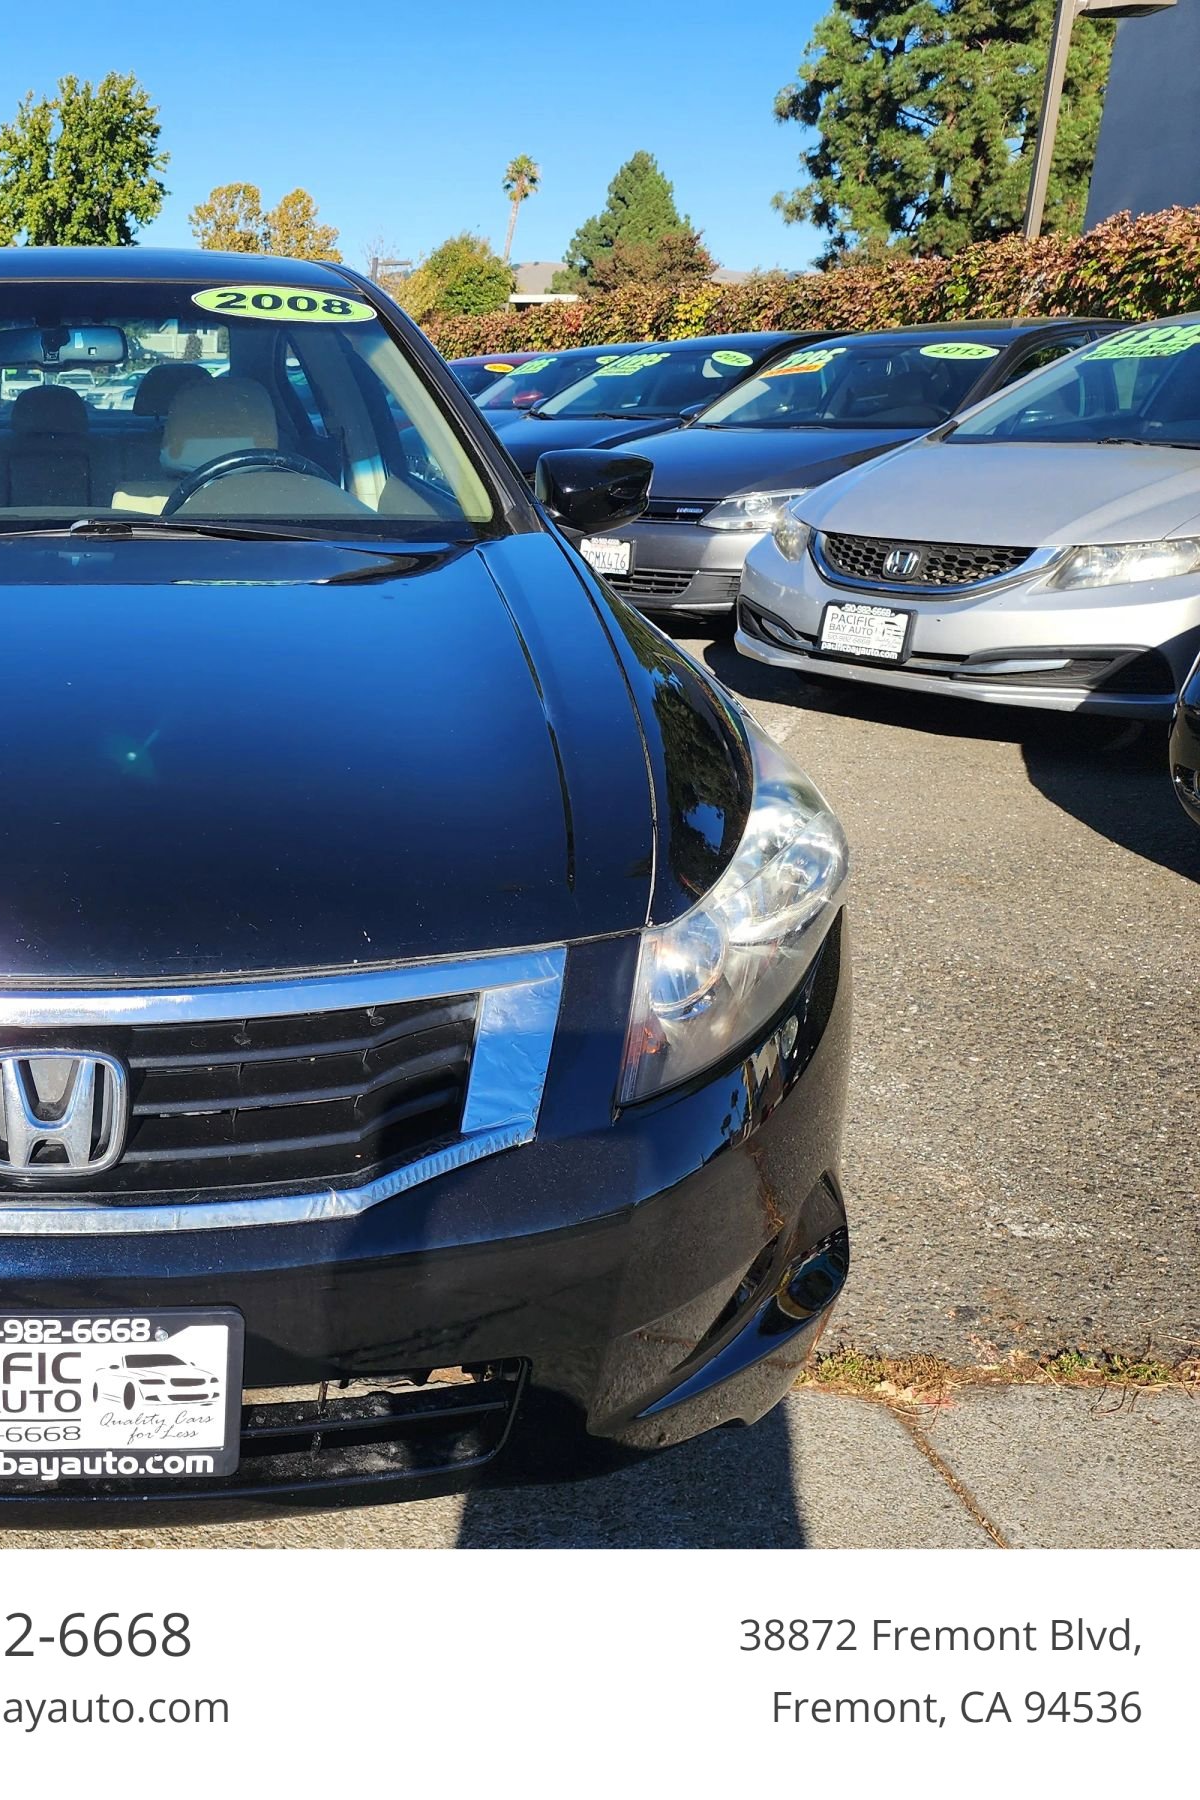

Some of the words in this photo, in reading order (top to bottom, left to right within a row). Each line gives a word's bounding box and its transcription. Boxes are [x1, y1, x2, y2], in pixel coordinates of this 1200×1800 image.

[214, 292, 353, 316] 2008
[927, 346, 988, 357] 2013
[828, 622, 847, 633] BAY
[848, 625, 874, 636] AUTO
[830, 612, 876, 628] PACIFIC
[821, 641, 898, 660] pacificbayauto.com
[99, 1411, 166, 1433] Quality
[175, 1409, 215, 1425] Cars
[127, 1426, 154, 1445] for
[159, 1424, 199, 1440] Less
